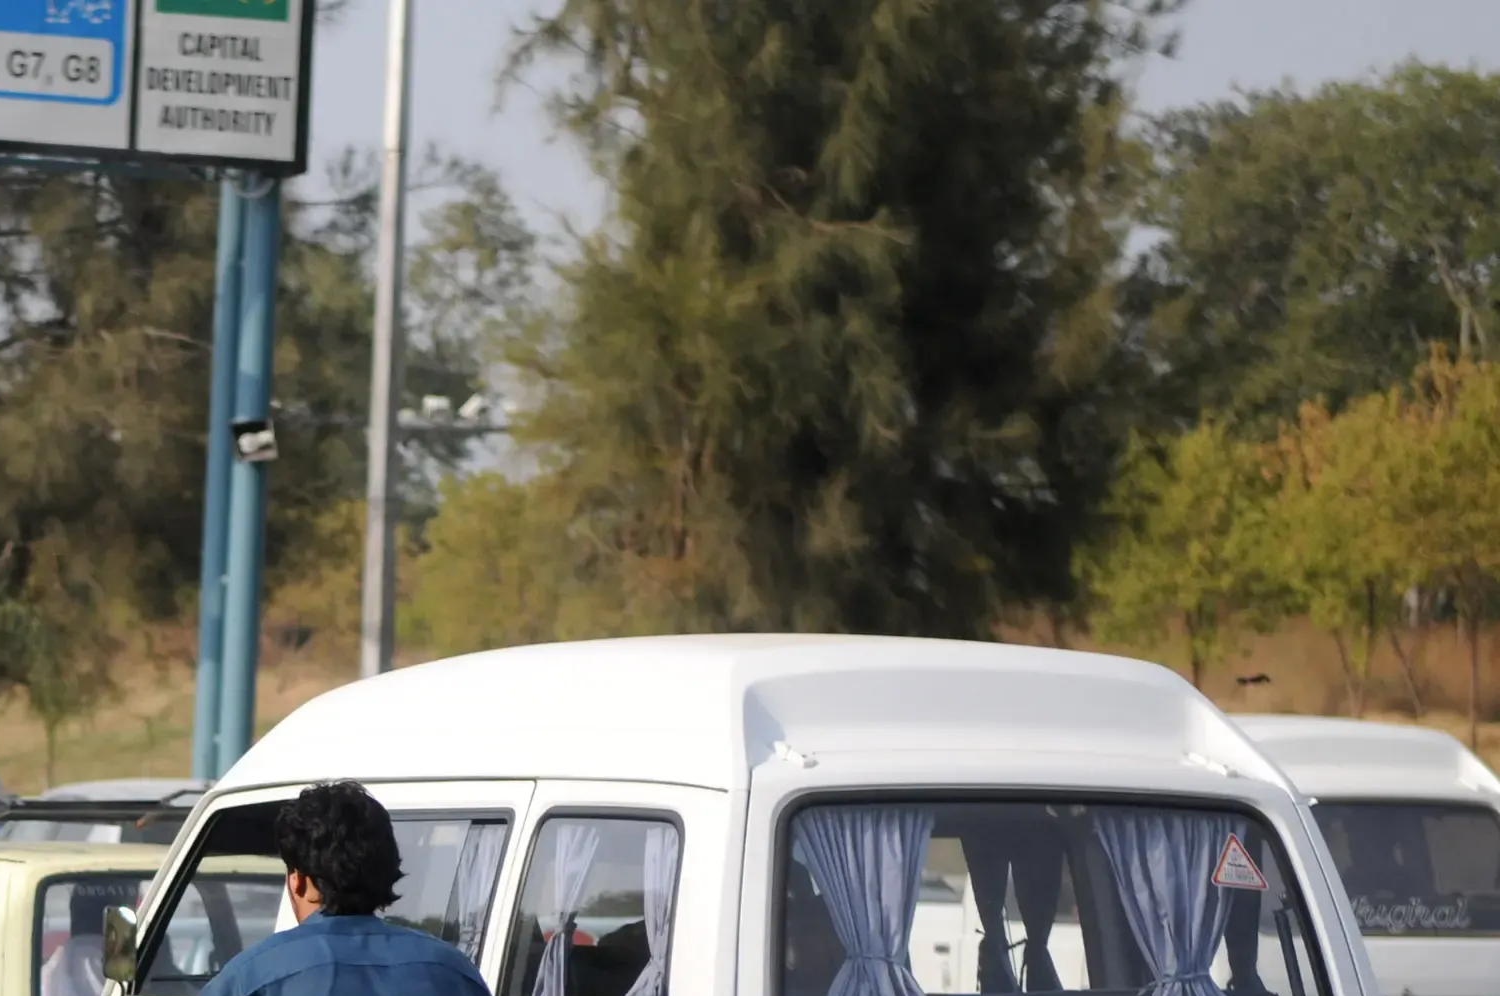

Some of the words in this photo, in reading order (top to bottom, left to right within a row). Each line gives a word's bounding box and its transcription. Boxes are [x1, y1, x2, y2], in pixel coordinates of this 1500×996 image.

[178, 32, 264, 62] CAPITAL
[6, 49, 53, 86] G7,
[61, 54, 101, 84] G8
[146, 66, 295, 101] DEVELOPMENT
[158, 104, 277, 137] AUTHORITY
